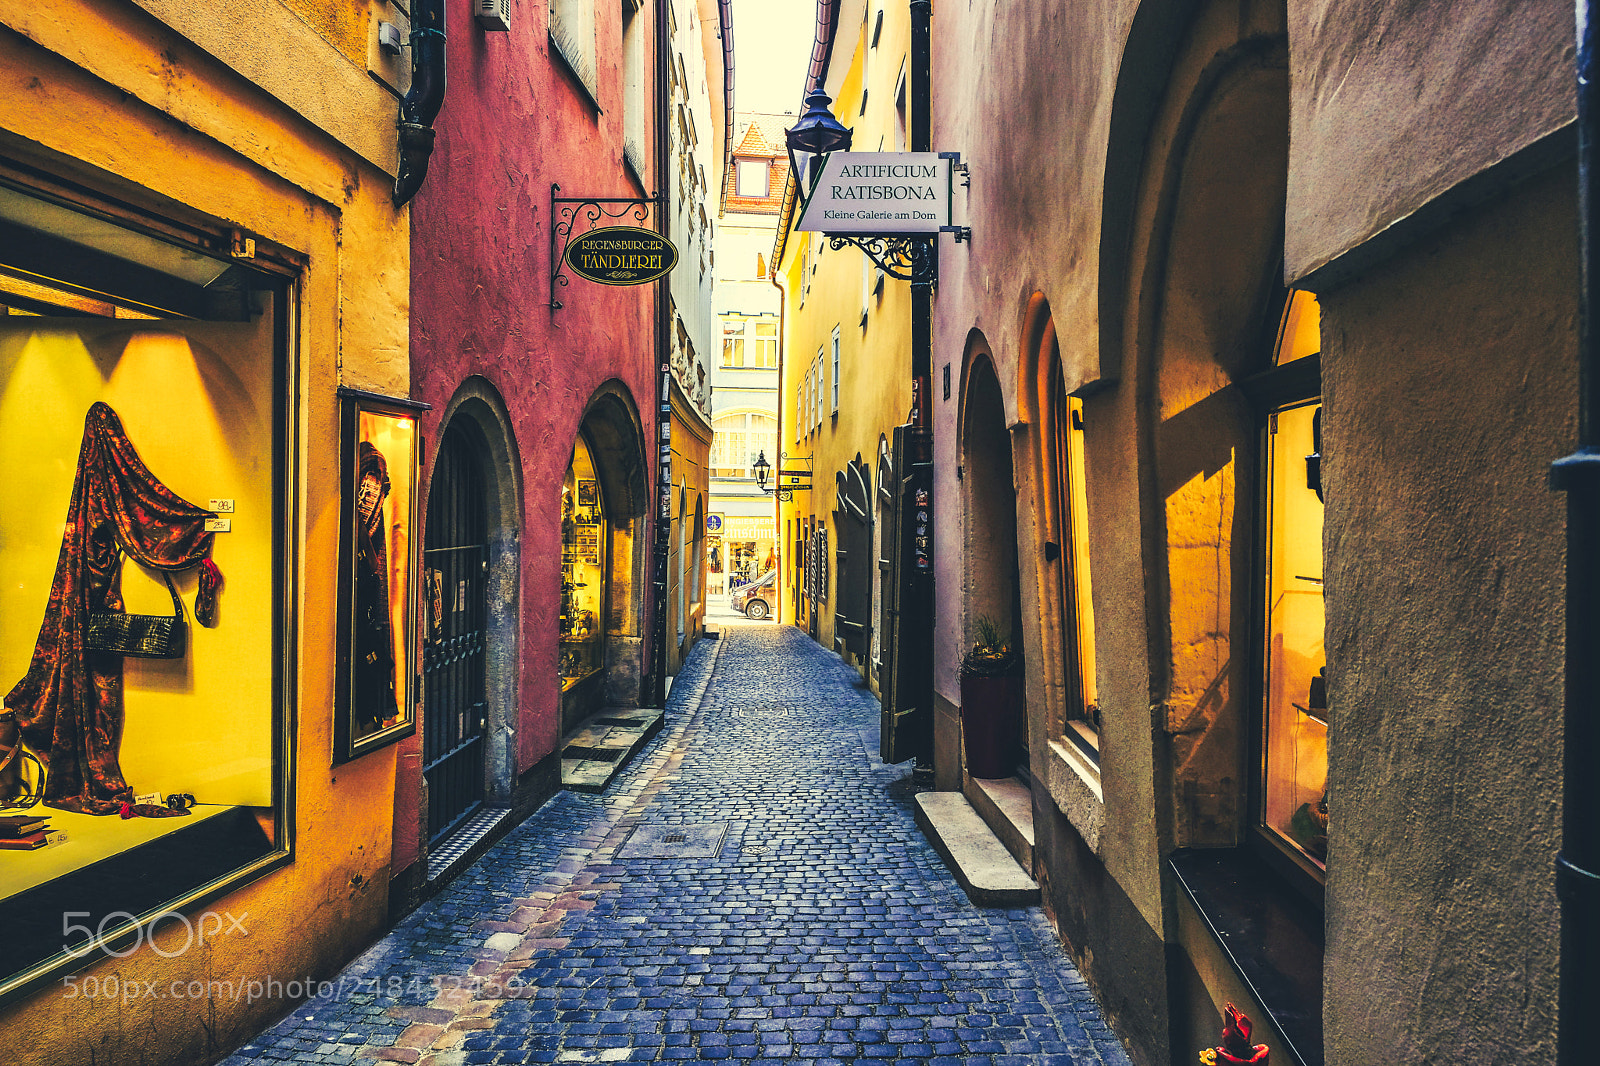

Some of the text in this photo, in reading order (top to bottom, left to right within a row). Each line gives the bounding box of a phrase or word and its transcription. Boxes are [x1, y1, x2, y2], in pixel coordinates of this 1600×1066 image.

[839, 165, 937, 178] ARTIFICIUM
[831, 185, 937, 200] RATISBONA
[824, 210, 937, 220] Kleine Galerie am Dom
[581, 240, 664, 250] REGENSBURGER
[581, 251, 663, 269] TÄNDLEREI
